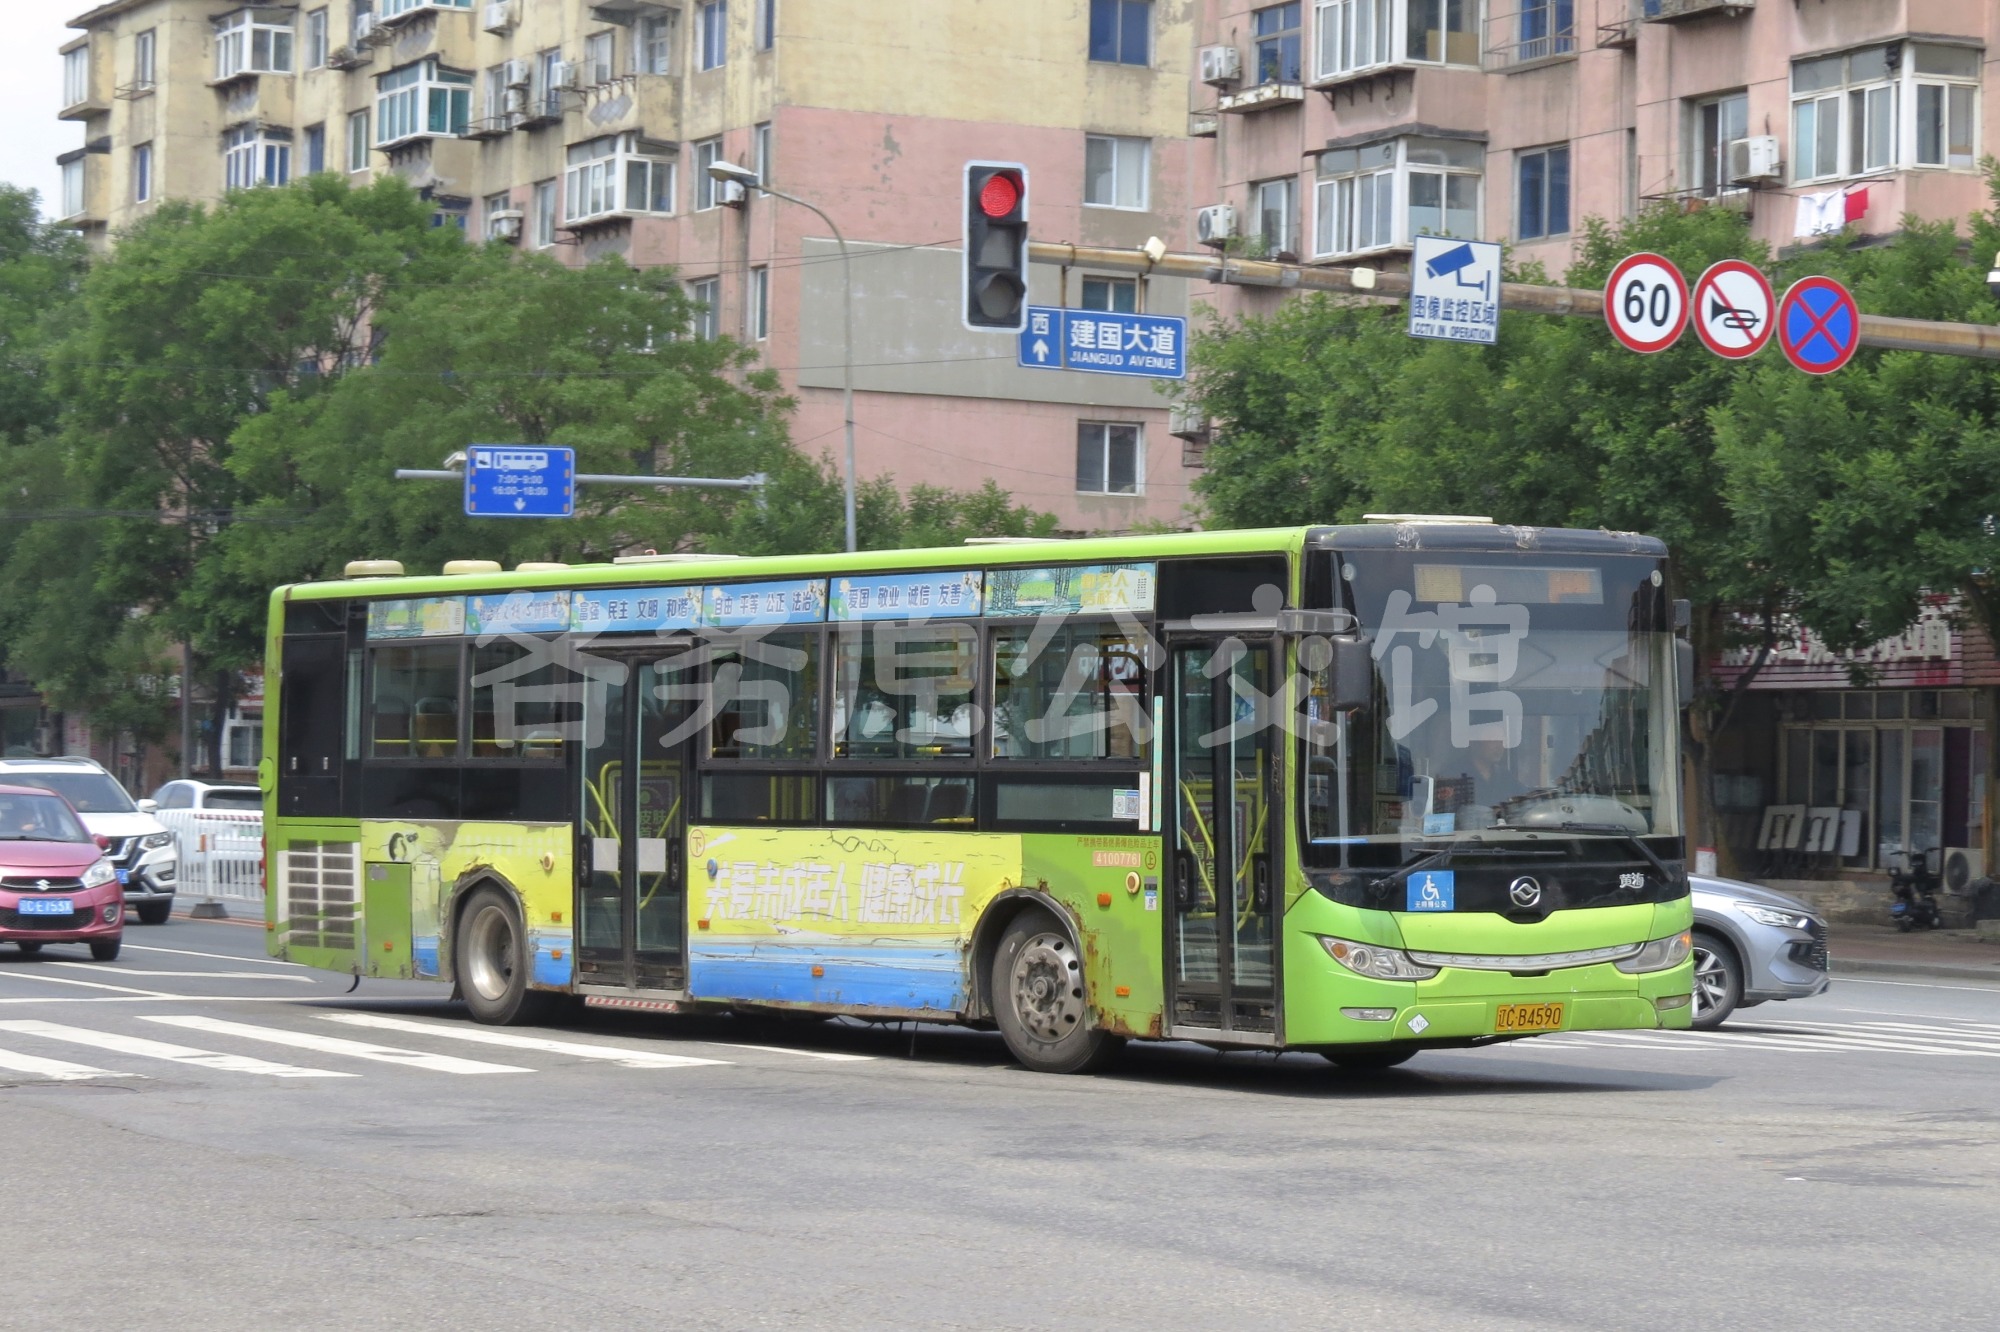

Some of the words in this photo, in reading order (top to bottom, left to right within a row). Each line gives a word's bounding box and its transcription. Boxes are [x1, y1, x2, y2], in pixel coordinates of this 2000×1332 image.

[1413, 295, 1496, 325] 图像监控区域
[1623, 279, 1670, 327] 60
[1031, 312, 1050, 335] 西
[1414, 322, 1435, 335] CCTV
[1438, 324, 1447, 336] IN
[1450, 326, 1493, 340] OPERATION
[1070, 319, 1176, 355] 建国大道
[1070, 350, 1123, 366] JIANGUO
[1129, 355, 1176, 370] AVENUE
[714, 596, 733, 616] 自由
[740, 594, 759, 614] 平等
[766, 593, 785, 613] 公正
[791, 592, 812, 612] 法治
[848, 587, 870, 609] 爱国
[878, 586, 900, 608] 敬业
[907, 585, 931, 607] 诚信
[938, 584, 962, 606] 友善
[579, 600, 600, 621] 富强
[608, 599, 628, 620] 民主
[637, 598, 658, 618] 文明
[666, 597, 689, 618] 和谐
[1618, 872, 1645, 889] 黄海
[704, 861, 849, 922] 关爱未成年人
[857, 862, 966, 925] 健康成长
[1411, 1019, 1426, 1029] LNG
